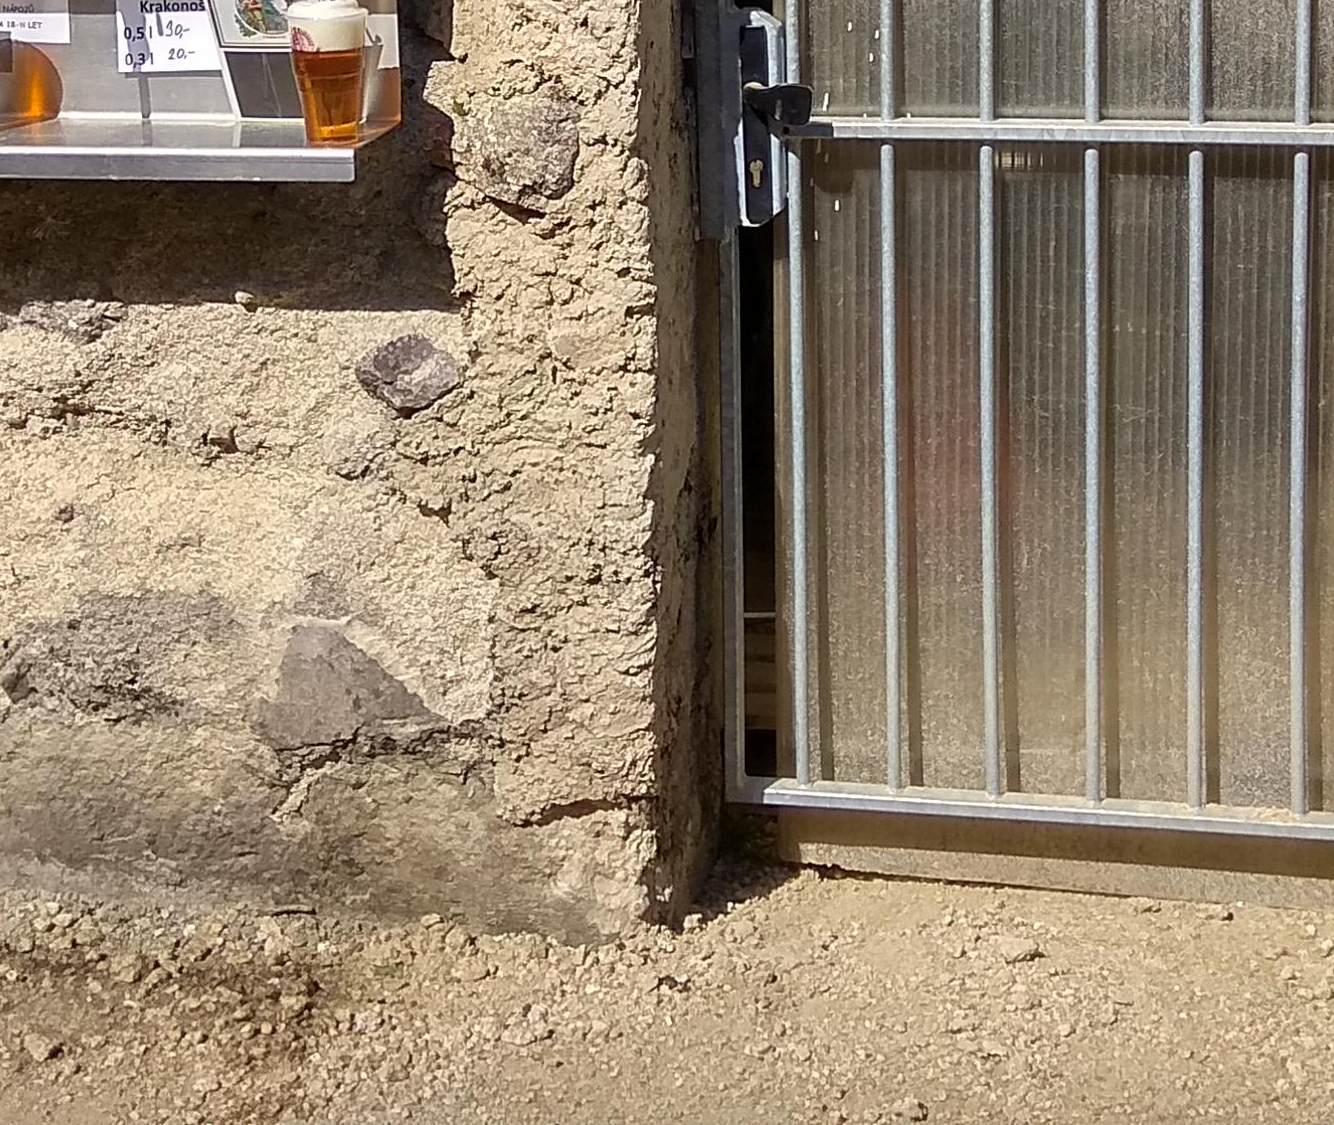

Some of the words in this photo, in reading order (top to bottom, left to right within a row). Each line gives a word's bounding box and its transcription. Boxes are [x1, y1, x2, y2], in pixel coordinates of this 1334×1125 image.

[140, 0, 206, 13] Krakonoš
[124, 27, 145, 42] 0,5
[125, 53, 146, 68] 0,3
